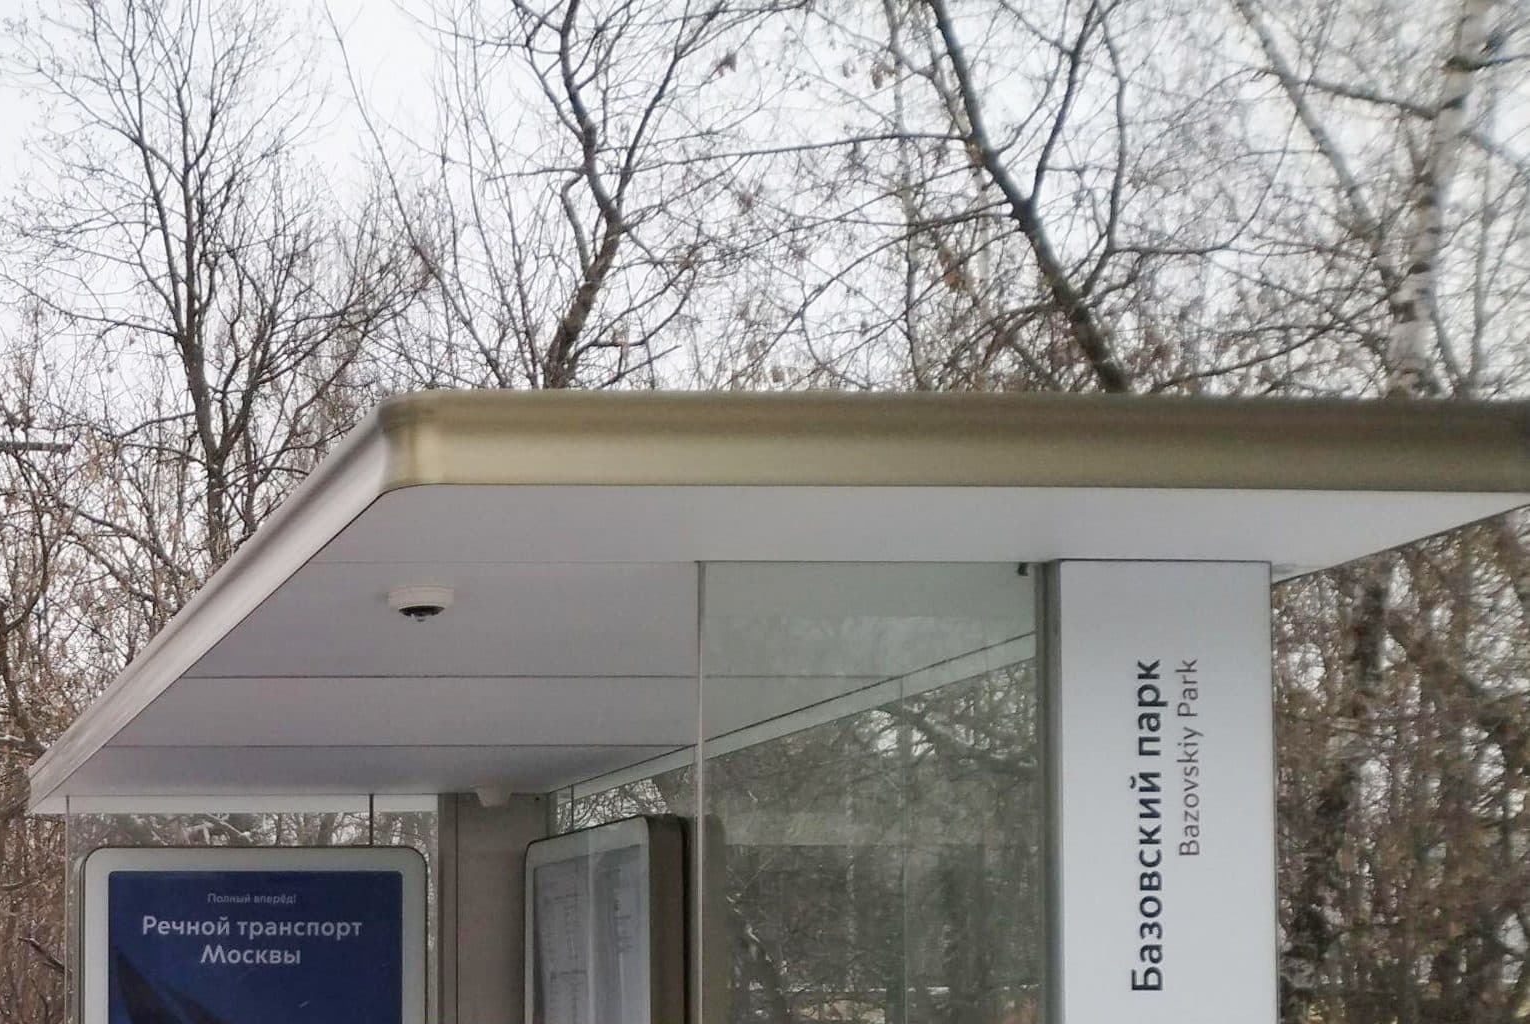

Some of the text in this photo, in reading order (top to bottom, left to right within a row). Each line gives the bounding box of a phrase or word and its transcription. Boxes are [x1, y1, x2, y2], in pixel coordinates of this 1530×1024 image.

[1175, 657, 1204, 857] Bazovskiy Park
[1130, 658, 1168, 993] Базовский парк
[207, 893, 250, 904] Полный
[142, 915, 363, 940] Речной транспорт
[200, 945, 301, 965] Москвы
